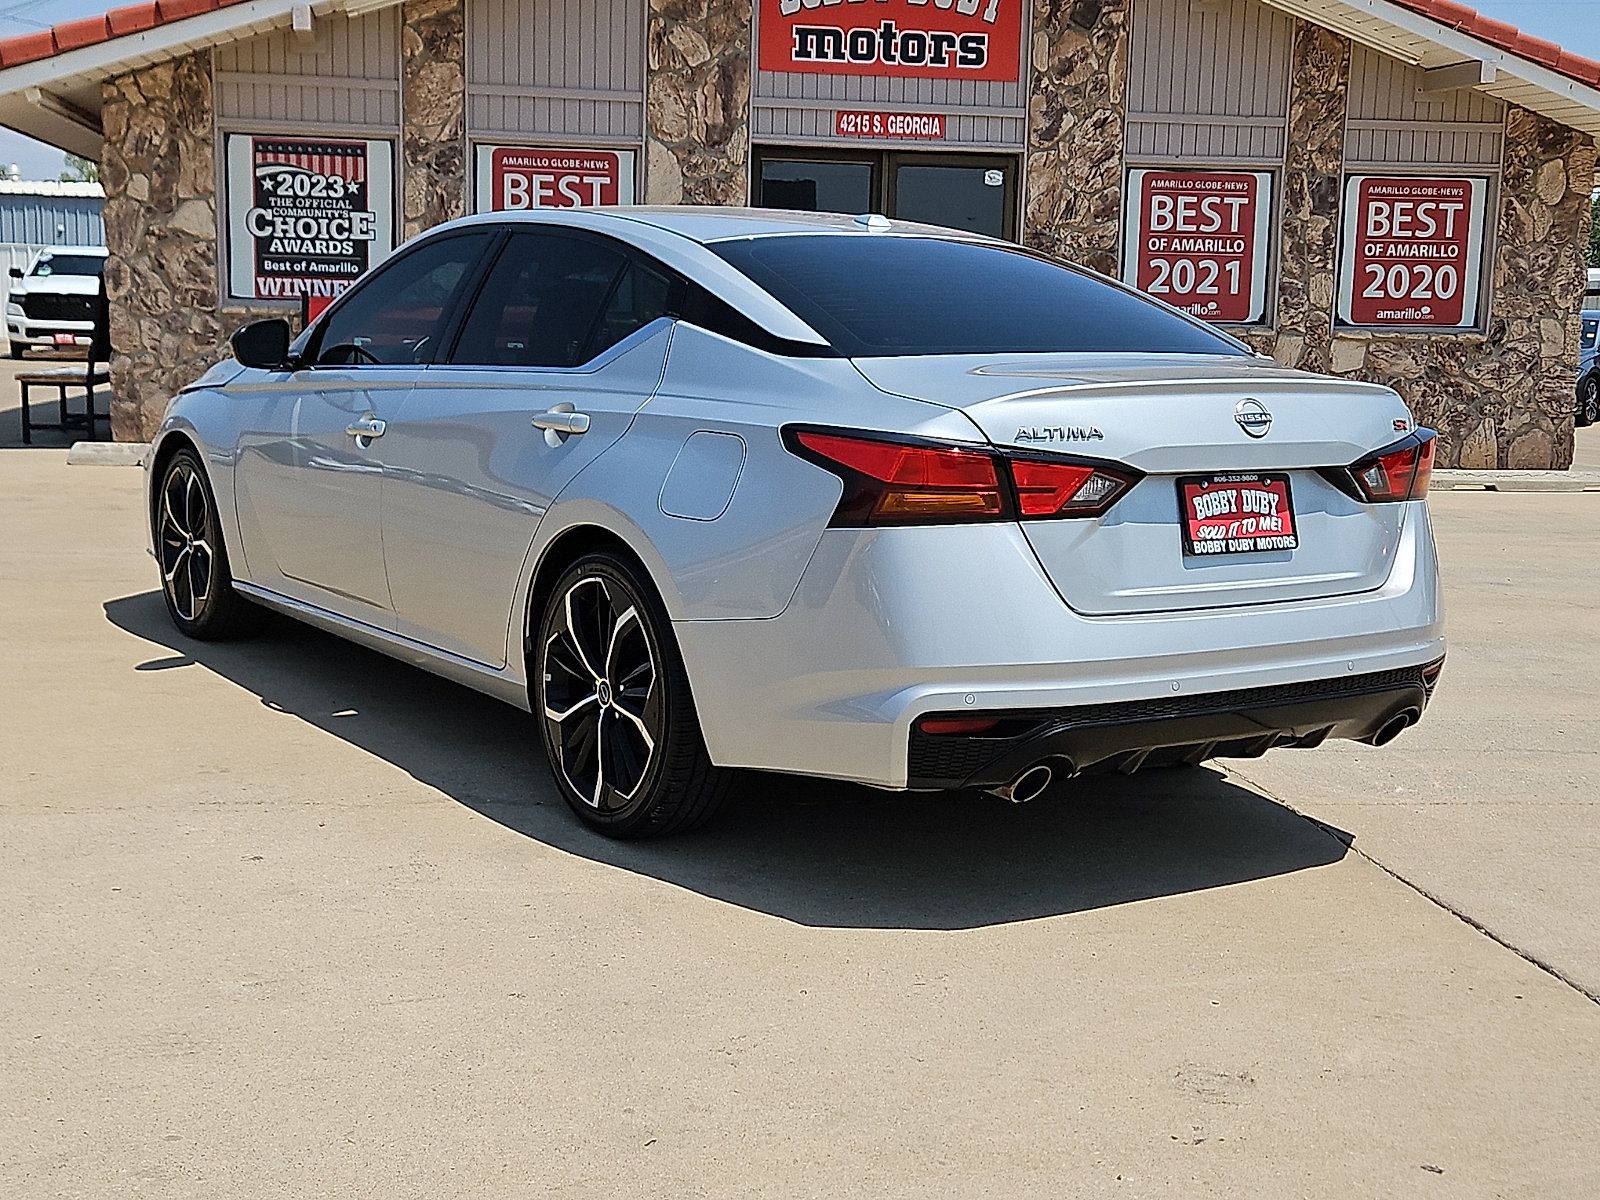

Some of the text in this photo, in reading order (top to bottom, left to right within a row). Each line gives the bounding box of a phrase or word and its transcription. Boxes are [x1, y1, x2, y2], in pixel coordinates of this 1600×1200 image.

[792, 20, 989, 69] motors
[839, 114, 940, 135] 4215 S. GEORGIA
[502, 156, 609, 169] AMARILLO GLOBE-NEWS
[276, 173, 345, 198] 2023
[503, 172, 611, 209] BEST
[1151, 179, 1249, 191] AMARILLO GLOBE-NEWS
[1368, 186, 1464, 196] AMARILLO GLOBE-NEWS
[269, 197, 352, 209] THE OFFICIAL
[273, 207, 349, 218] COMMUNITY'S
[246, 207, 376, 240] CHOICE
[1150, 195, 1249, 233] BEST
[1367, 201, 1464, 238] BEST
[269, 239, 354, 255] AWARDS
[1148, 238, 1245, 253] OF AMARILLO
[1364, 243, 1459, 258] OF AMARILLO
[264, 260, 359, 273] Best of Amarillo
[1147, 258, 1240, 295] 2021
[1362, 263, 1458, 299] 2020
[257, 277, 356, 297] WINNE
[1235, 414, 1272, 422] NISSAN
[1014, 426, 1104, 443] ALTIMA
[1193, 489, 1279, 520] BOBBY DUBY
[1196, 516, 1282, 540] SOLD IT TO ME!
[1193, 536, 1296, 554] BOBBY DUBY MOTORS
